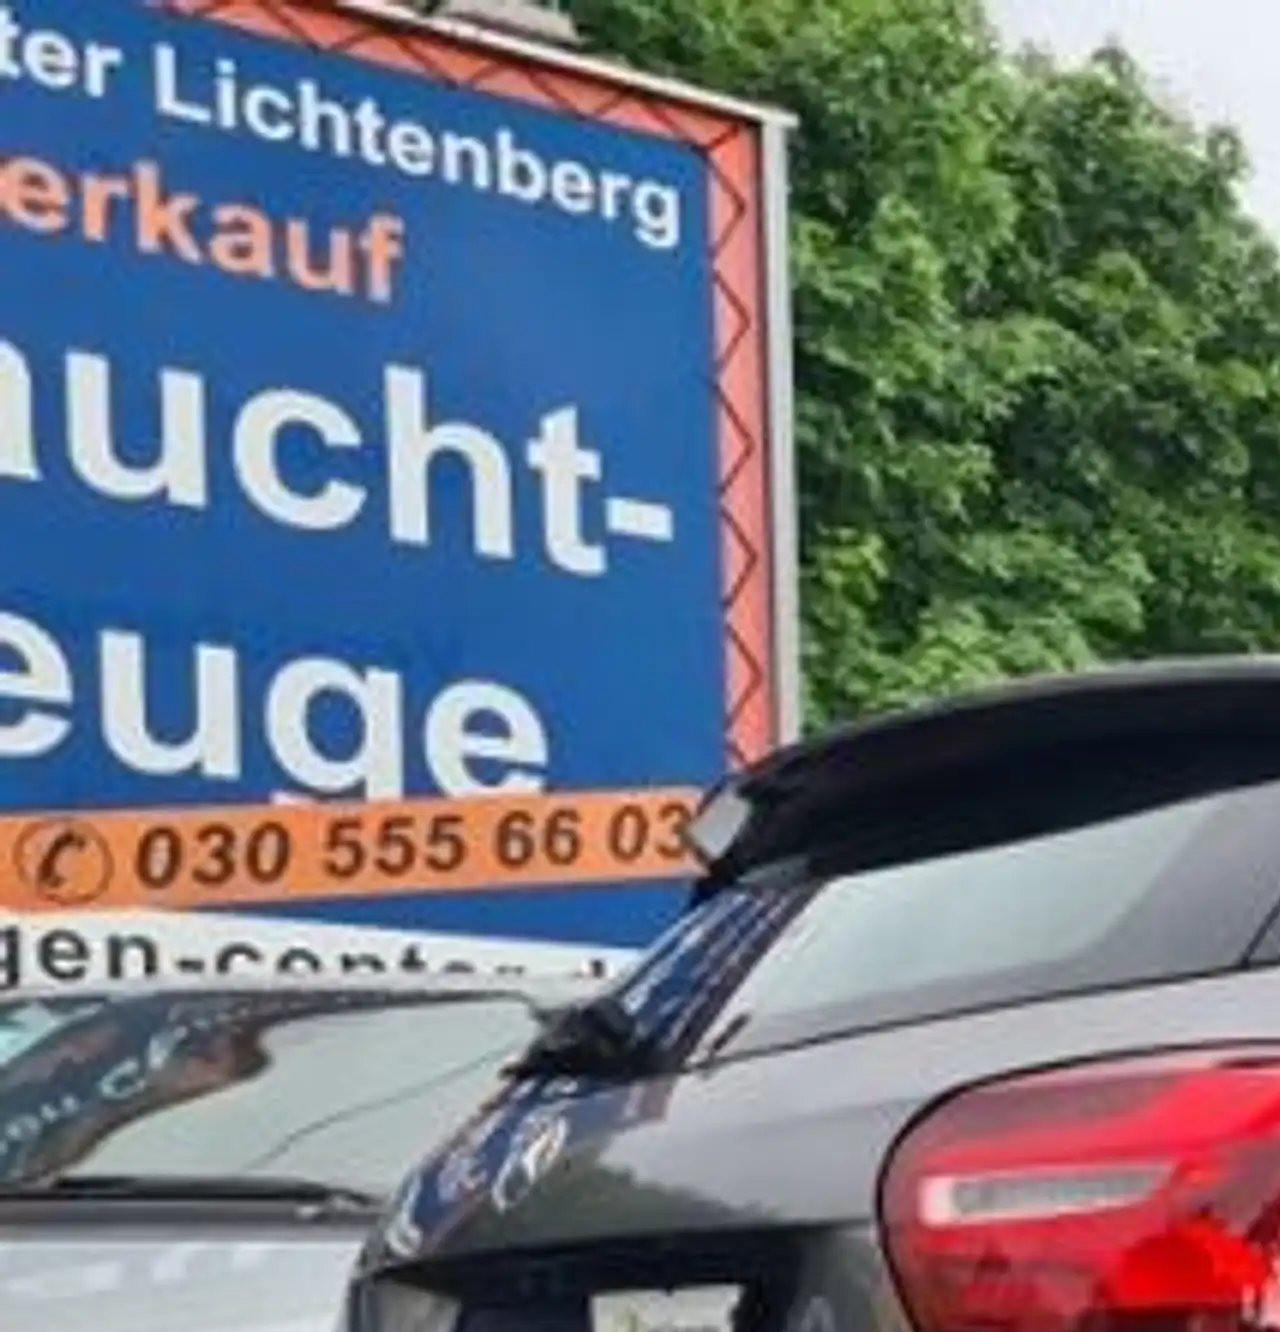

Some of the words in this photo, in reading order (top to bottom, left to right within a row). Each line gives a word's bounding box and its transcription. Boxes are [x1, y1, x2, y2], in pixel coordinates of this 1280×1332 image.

[0, 5, 124, 97] ter
[154, 41, 682, 249] Lichtenberg
[0, 156, 405, 303] erkauf
[0, 610, 549, 804] euge
[136, 820, 291, 889] 030
[323, 813, 467, 879] 555
[495, 808, 582, 868] 66
[608, 803, 695, 862] 03
